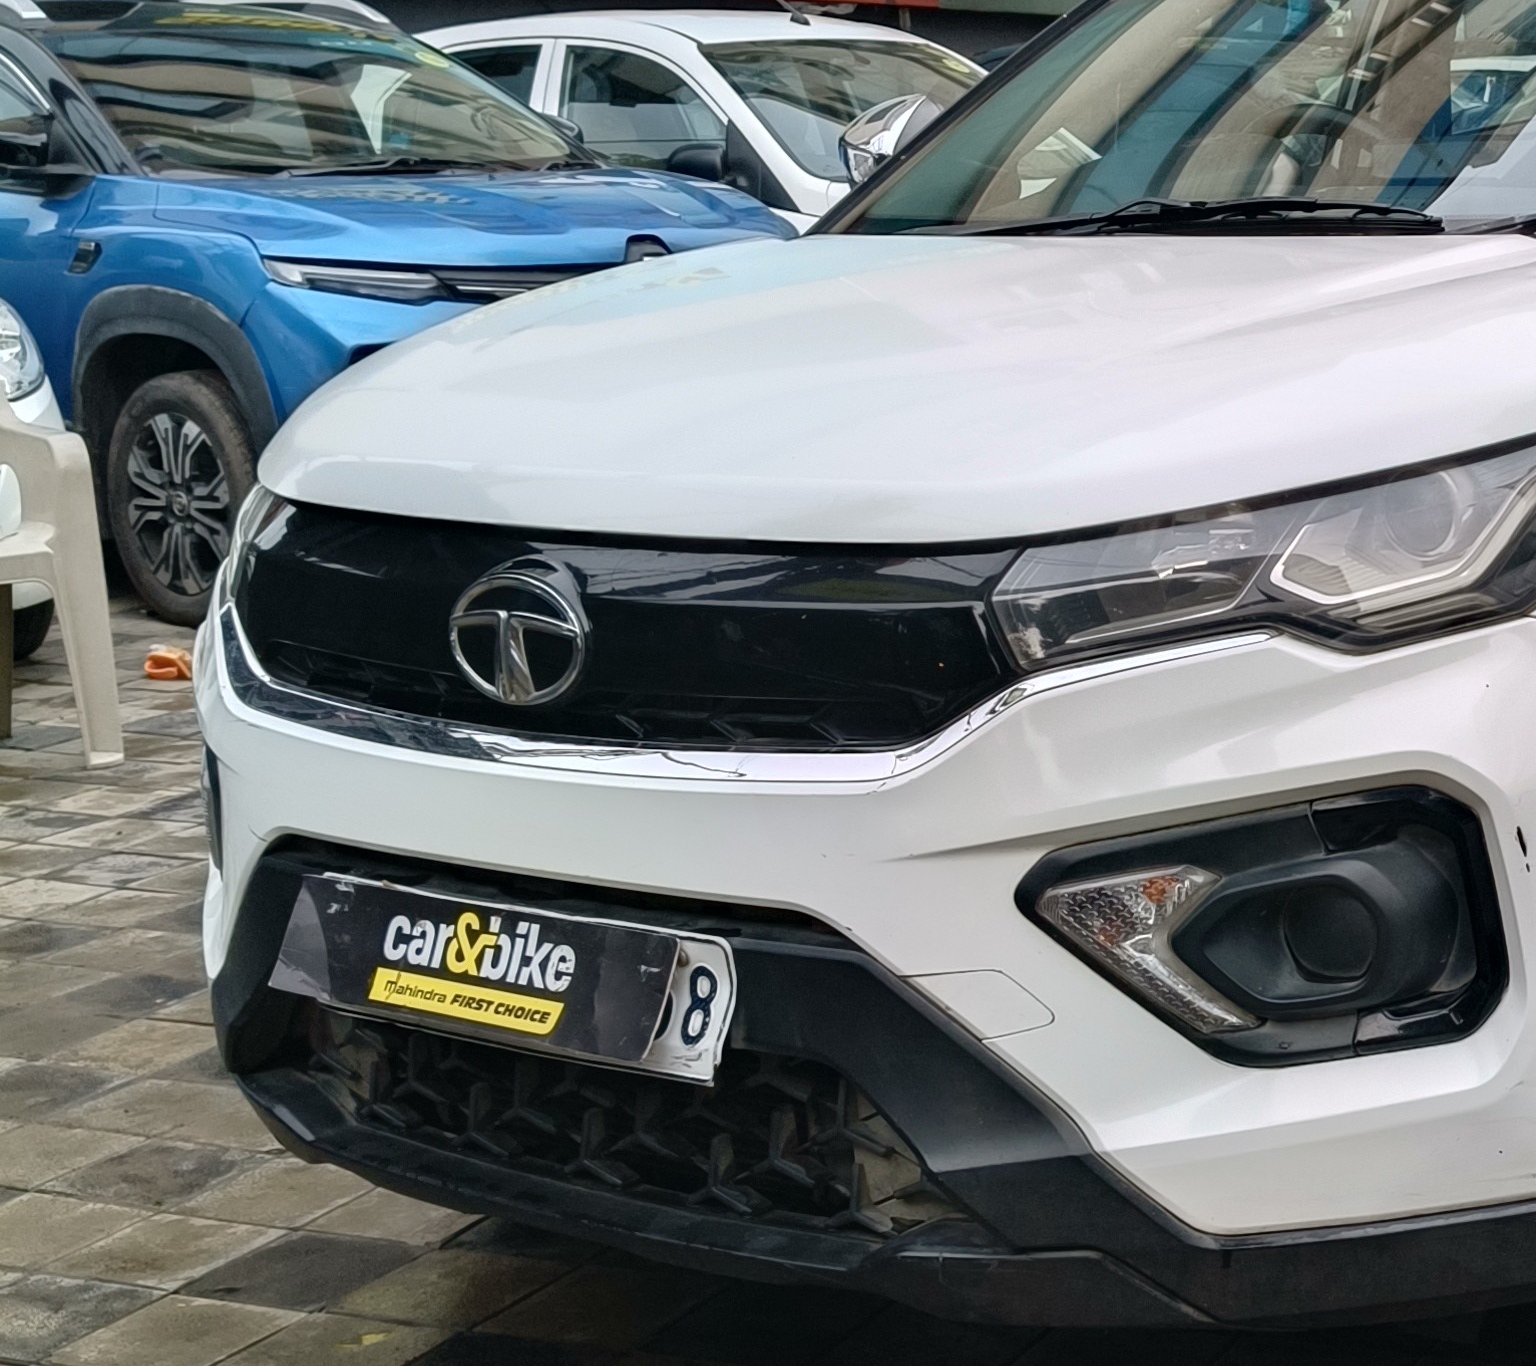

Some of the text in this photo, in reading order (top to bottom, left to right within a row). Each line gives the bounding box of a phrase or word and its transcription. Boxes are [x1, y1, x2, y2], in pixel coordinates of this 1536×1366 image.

[383, 912, 577, 993] car&bike
[449, 993, 495, 1012] FIRST
[493, 1001, 552, 1025] CHOICE
